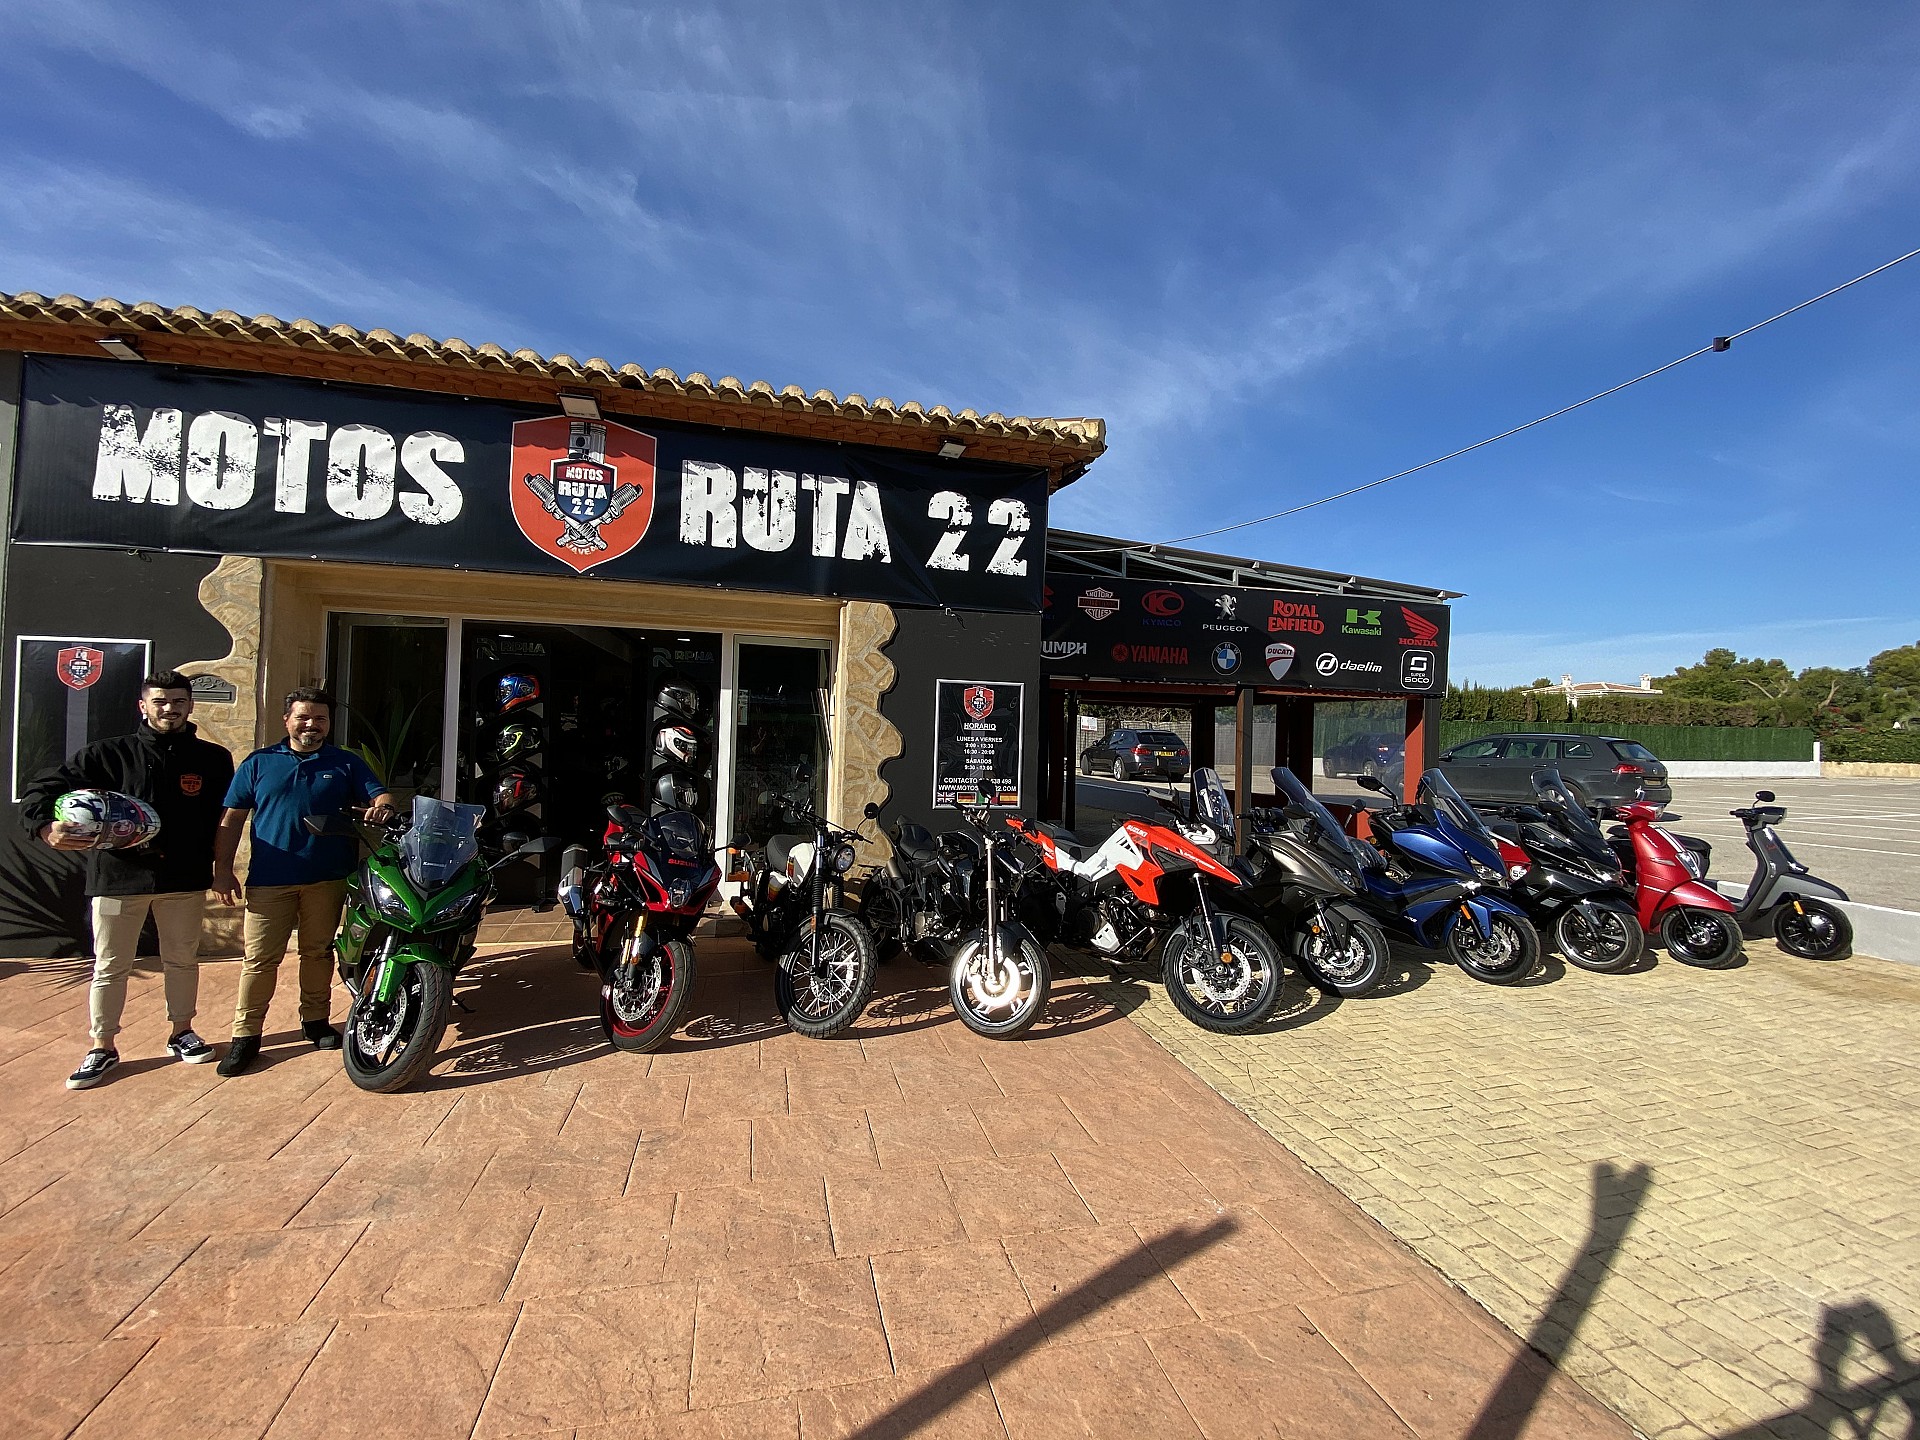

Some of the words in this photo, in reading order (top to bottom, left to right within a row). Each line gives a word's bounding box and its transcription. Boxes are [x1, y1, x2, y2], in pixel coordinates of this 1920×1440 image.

[92, 404, 465, 526] MOTOS
[566, 466, 604, 482] MOTOS
[558, 480, 608, 500] RUTA
[571, 498, 595, 516] 22
[680, 459, 892, 564] RUTA
[925, 490, 1031, 577] 22
[1273, 599, 1319, 618] ROYAL
[1142, 617, 1182, 627] KYMCO
[1202, 623, 1250, 633] PEUGEOT
[1267, 616, 1325, 635] ENFIELD
[1341, 624, 1382, 636] Kawasaki
[1041, 640, 1088, 655] UMPH
[1398, 637, 1439, 647] HONDA
[1131, 644, 1189, 665] YAMAHA
[1267, 647, 1293, 656] DUCATI
[1340, 659, 1383, 673] daelim
[1404, 676, 1430, 684] SOCO
[963, 722, 997, 730] HORARIO
[1126, 824, 1149, 838] SUZUKI
[667, 858, 699, 869] SUZUKI
